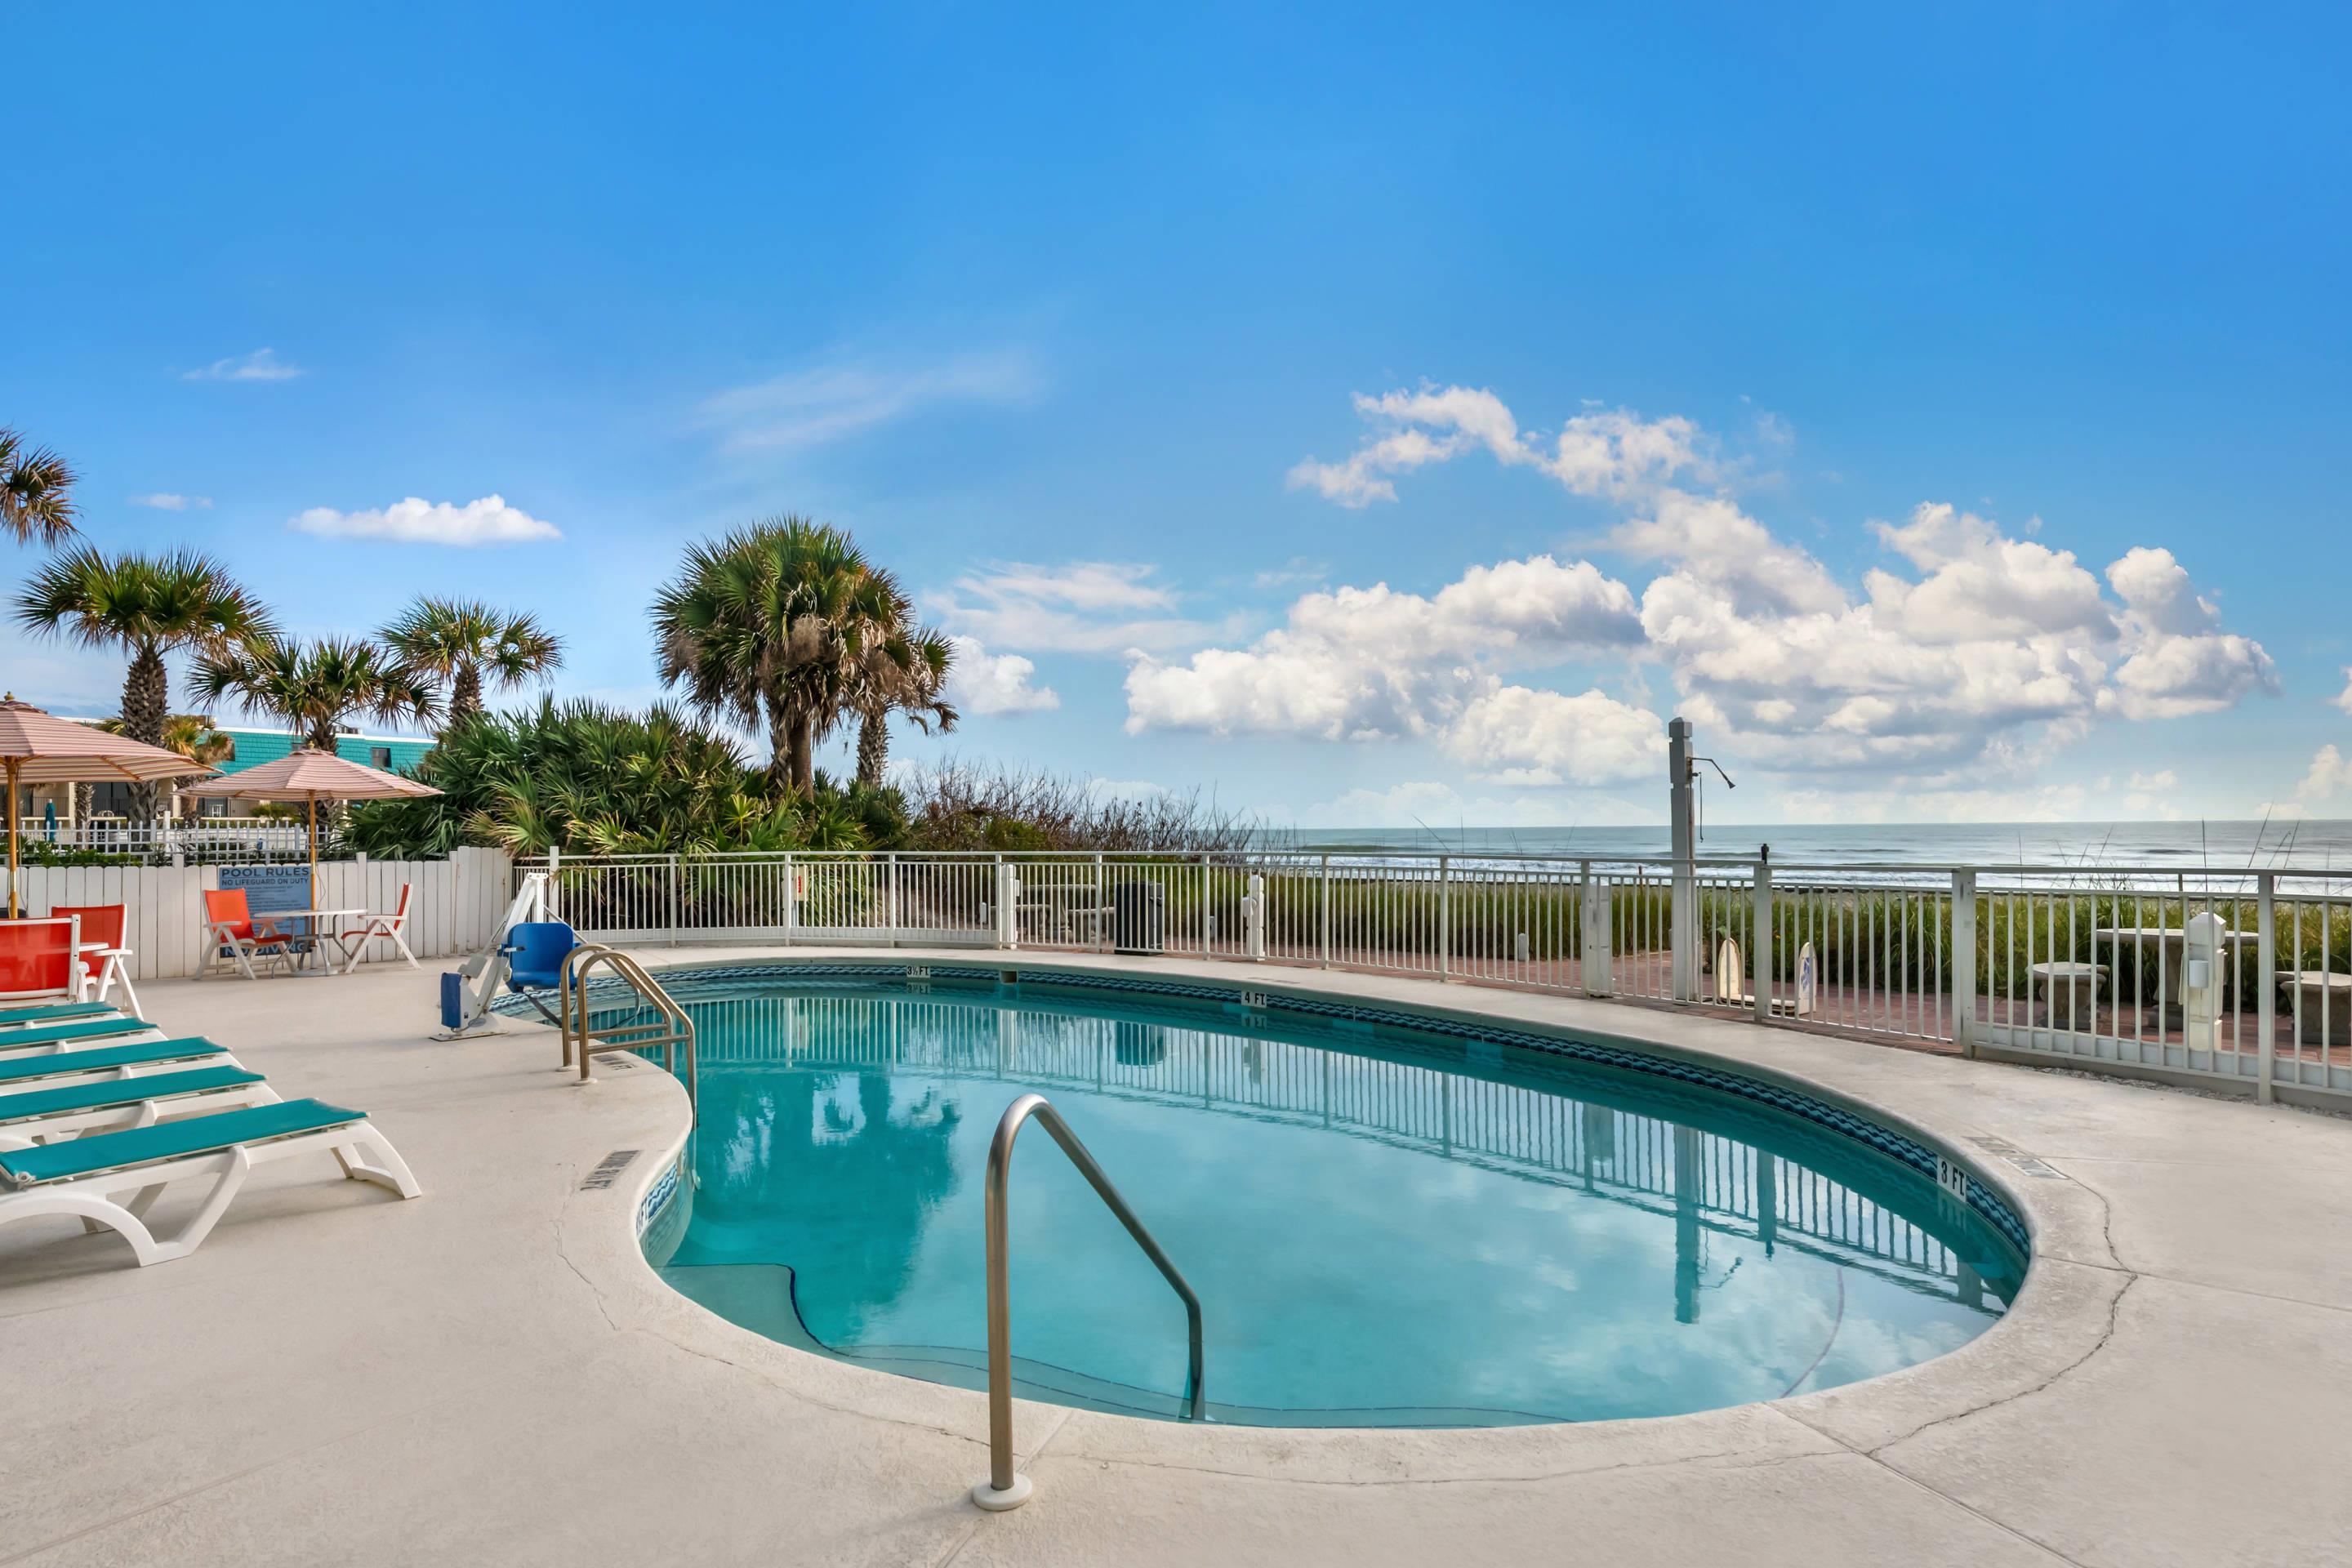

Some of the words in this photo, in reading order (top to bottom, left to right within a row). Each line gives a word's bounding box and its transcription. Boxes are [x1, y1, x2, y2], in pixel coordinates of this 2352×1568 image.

[221, 868, 261, 877] POOL
[265, 867, 310, 876] RULES
[1245, 991, 1250, 1004] 4
[1941, 1160, 1948, 1184] 3
